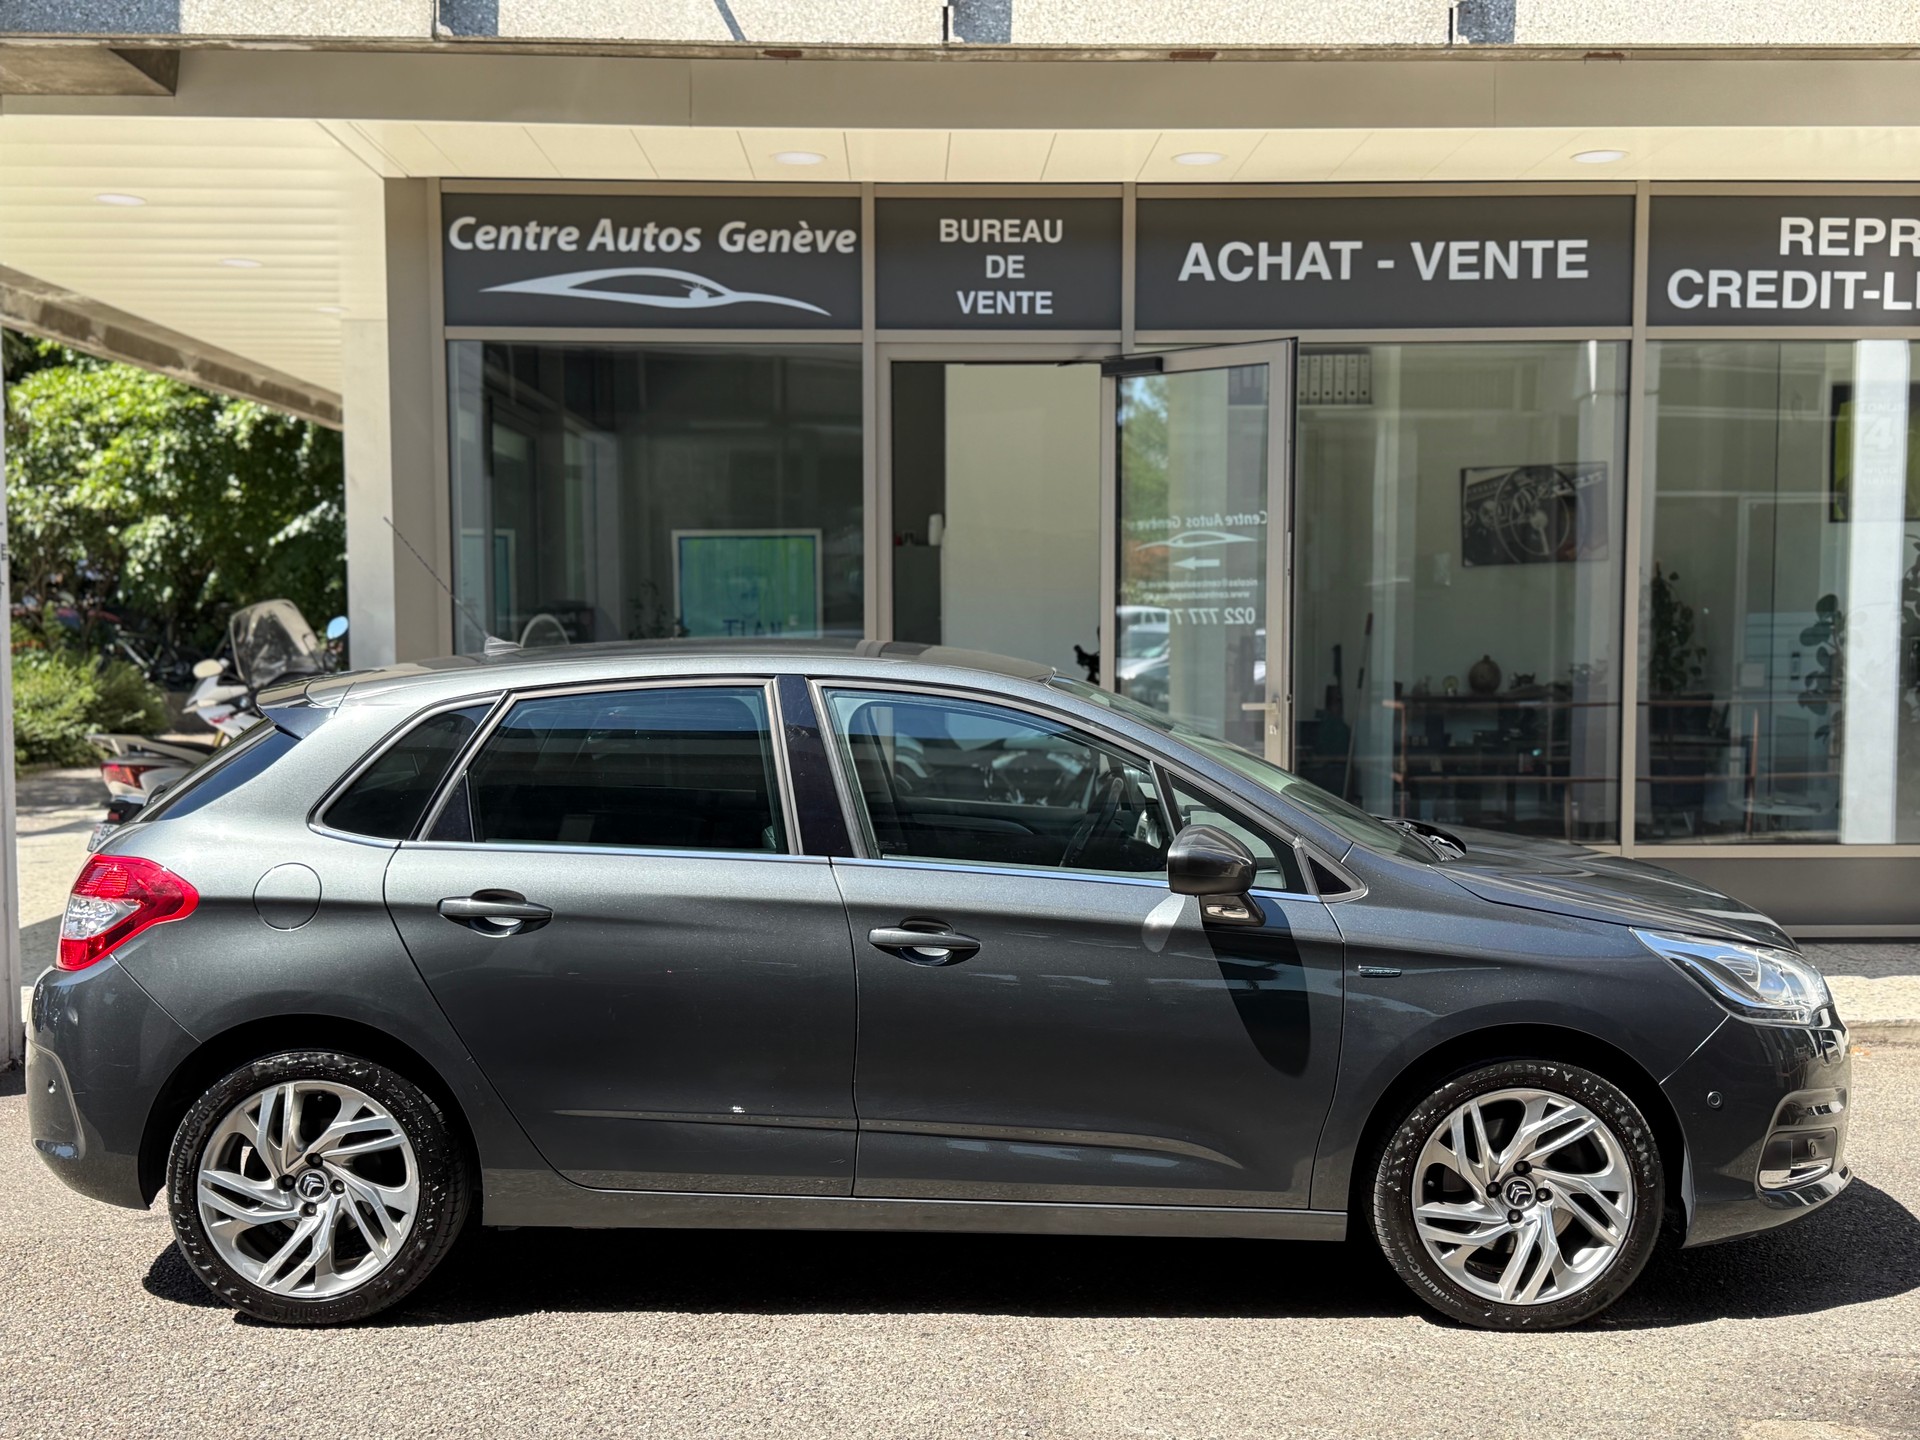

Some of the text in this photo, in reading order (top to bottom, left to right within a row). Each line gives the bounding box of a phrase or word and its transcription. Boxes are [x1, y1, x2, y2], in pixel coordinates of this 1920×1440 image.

[450, 217, 856, 253] Centre Autos Genève
[941, 219, 1062, 242] BUREAU
[1780, 217, 1920, 257] REPR
[987, 256, 1024, 278] DE
[1179, 241, 1362, 281] ACHAT
[1411, 240, 1588, 280] VENTE
[957, 291, 1052, 314] VENTE
[1668, 269, 1920, 310] CREDIT-L
